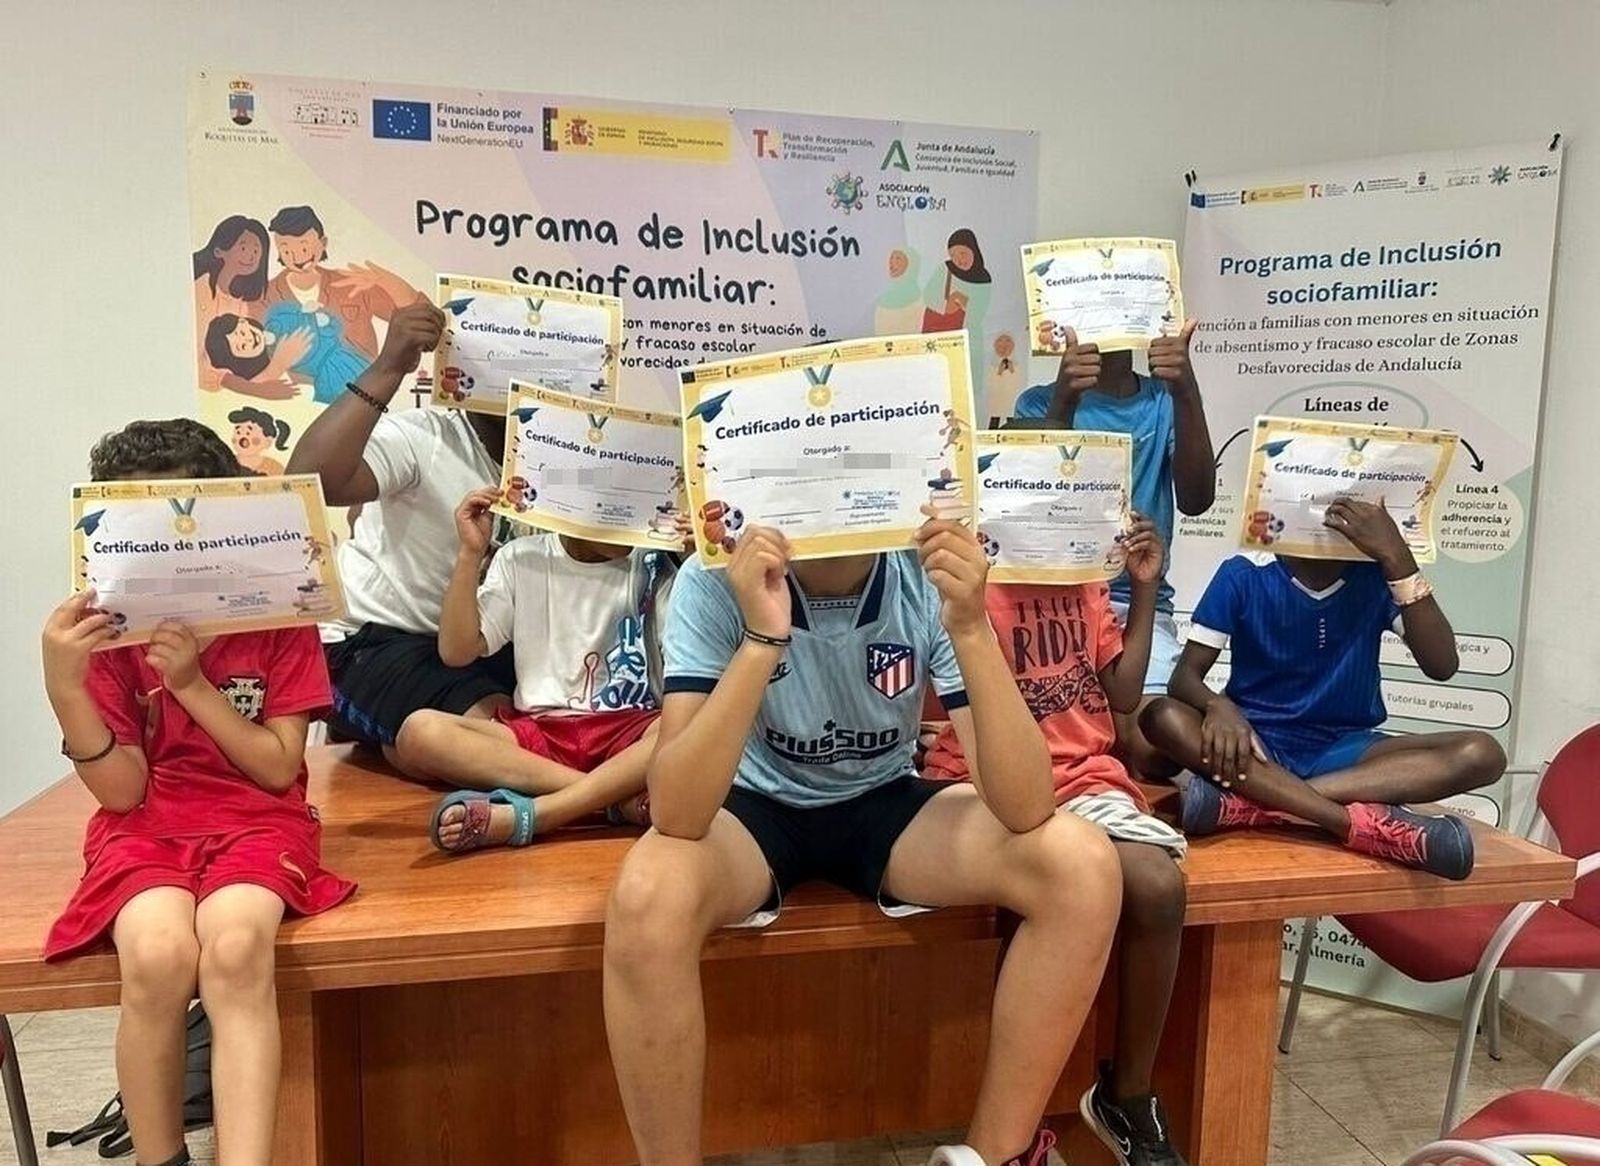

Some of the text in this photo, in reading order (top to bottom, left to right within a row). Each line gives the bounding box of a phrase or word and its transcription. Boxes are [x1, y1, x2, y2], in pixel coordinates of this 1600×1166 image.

[437, 103, 522, 121] Financiado por
[437, 118, 534, 135] la Unión Europea
[437, 134, 523, 148] NextGenerationEU
[782, 132, 800, 142] Plan
[783, 142, 848, 154] Transformación
[917, 142, 996, 155] Junta de Andalucía
[879, 183, 930, 194] ASOCIACIÓN
[416, 200, 861, 259] Programa de Inclusión
[1220, 237, 1502, 278] Programa de Inclusión
[1046, 274, 1098, 287] Certificado
[1101, 273, 1112, 281] de
[1266, 278, 1438, 305] sociofamiliar:
[1249, 322, 1257, 330] a
[1261, 314, 1320, 330] familias
[1324, 316, 1352, 327] con
[1357, 312, 1428, 326] menores
[1432, 311, 1453, 323] en
[1457, 304, 1539, 322] situación
[461, 321, 604, 345] Certificado de participación
[650, 319, 711, 333] menores
[718, 322, 735, 333] en
[741, 321, 804, 336] situación
[810, 324, 826, 338] de
[636, 335, 695, 352] fracaso
[702, 337, 756, 353] escolar
[1194, 332, 1518, 353] de absentismo y fracaso escolar de Zonas
[1237, 356, 1462, 375] Desfavorecidas de Andalucía
[1304, 396, 1389, 412] Líneas de
[715, 402, 940, 440] Certificado de participación
[525, 429, 675, 468] Certificado de participación
[803, 445, 842, 456] Otorgado
[1274, 462, 1426, 484] Certificado de participación
[983, 478, 1051, 490] Certificado
[1055, 480, 1070, 491] de
[1456, 483, 1499, 494] Línea 4
[1448, 500, 1508, 510] Propiciar la
[1180, 517, 1226, 526] dinámicas
[1441, 512, 1511, 526] adherencia y
[1441, 527, 1510, 537] el refuerzo al
[93, 531, 302, 555] Certificado de participación
[1483, 645, 1490, 654] y
[1387, 693, 1474, 712] Tutorías grupales
